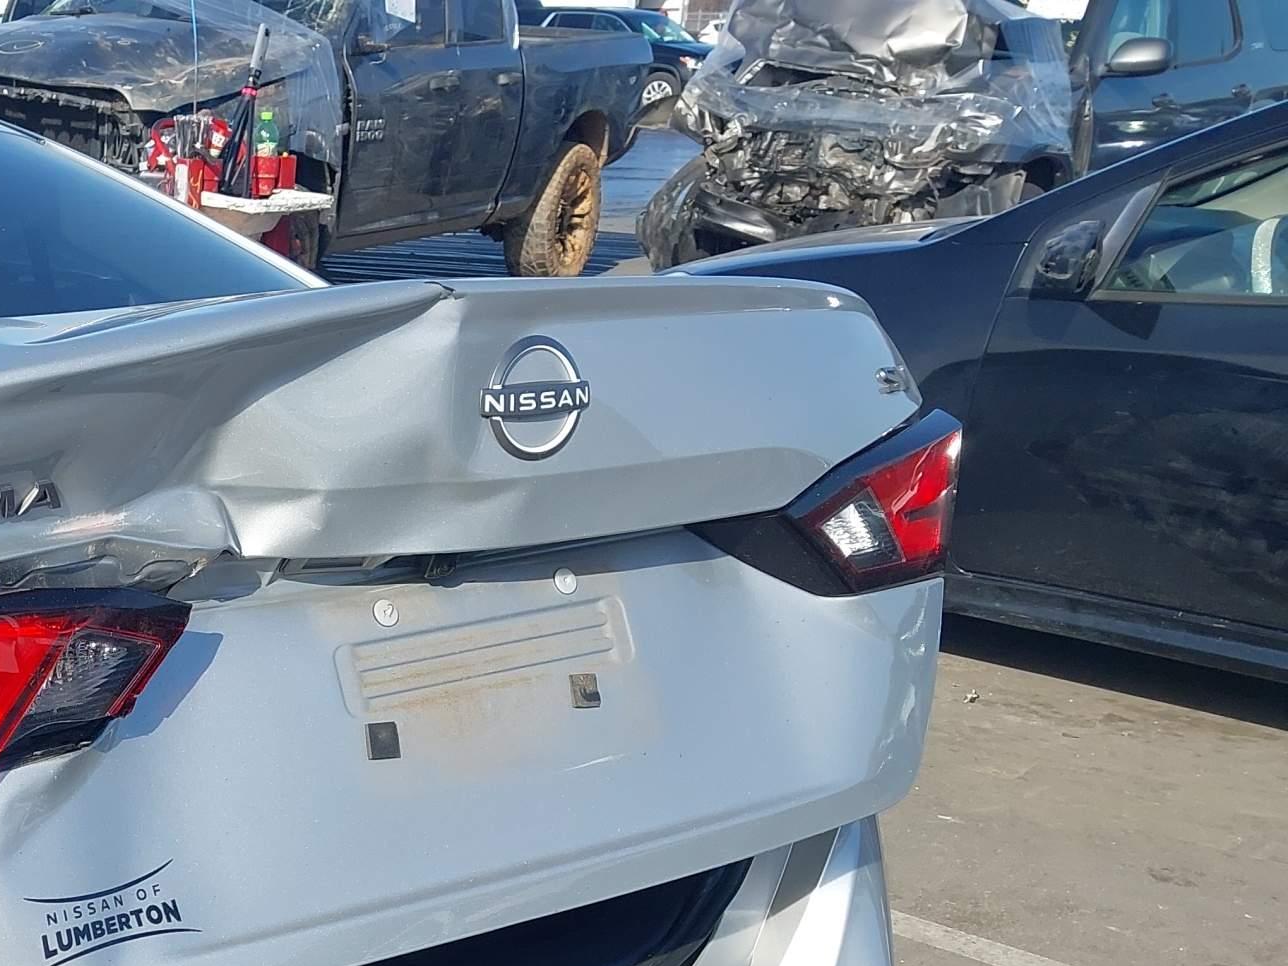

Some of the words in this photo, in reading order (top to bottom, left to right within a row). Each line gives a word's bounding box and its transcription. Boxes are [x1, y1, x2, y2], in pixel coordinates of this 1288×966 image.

[483, 385, 590, 414] NISSAN
[45, 894, 124, 927] NISSAN
[135, 883, 161, 901] OF
[40, 898, 183, 960] LUMBERTON
